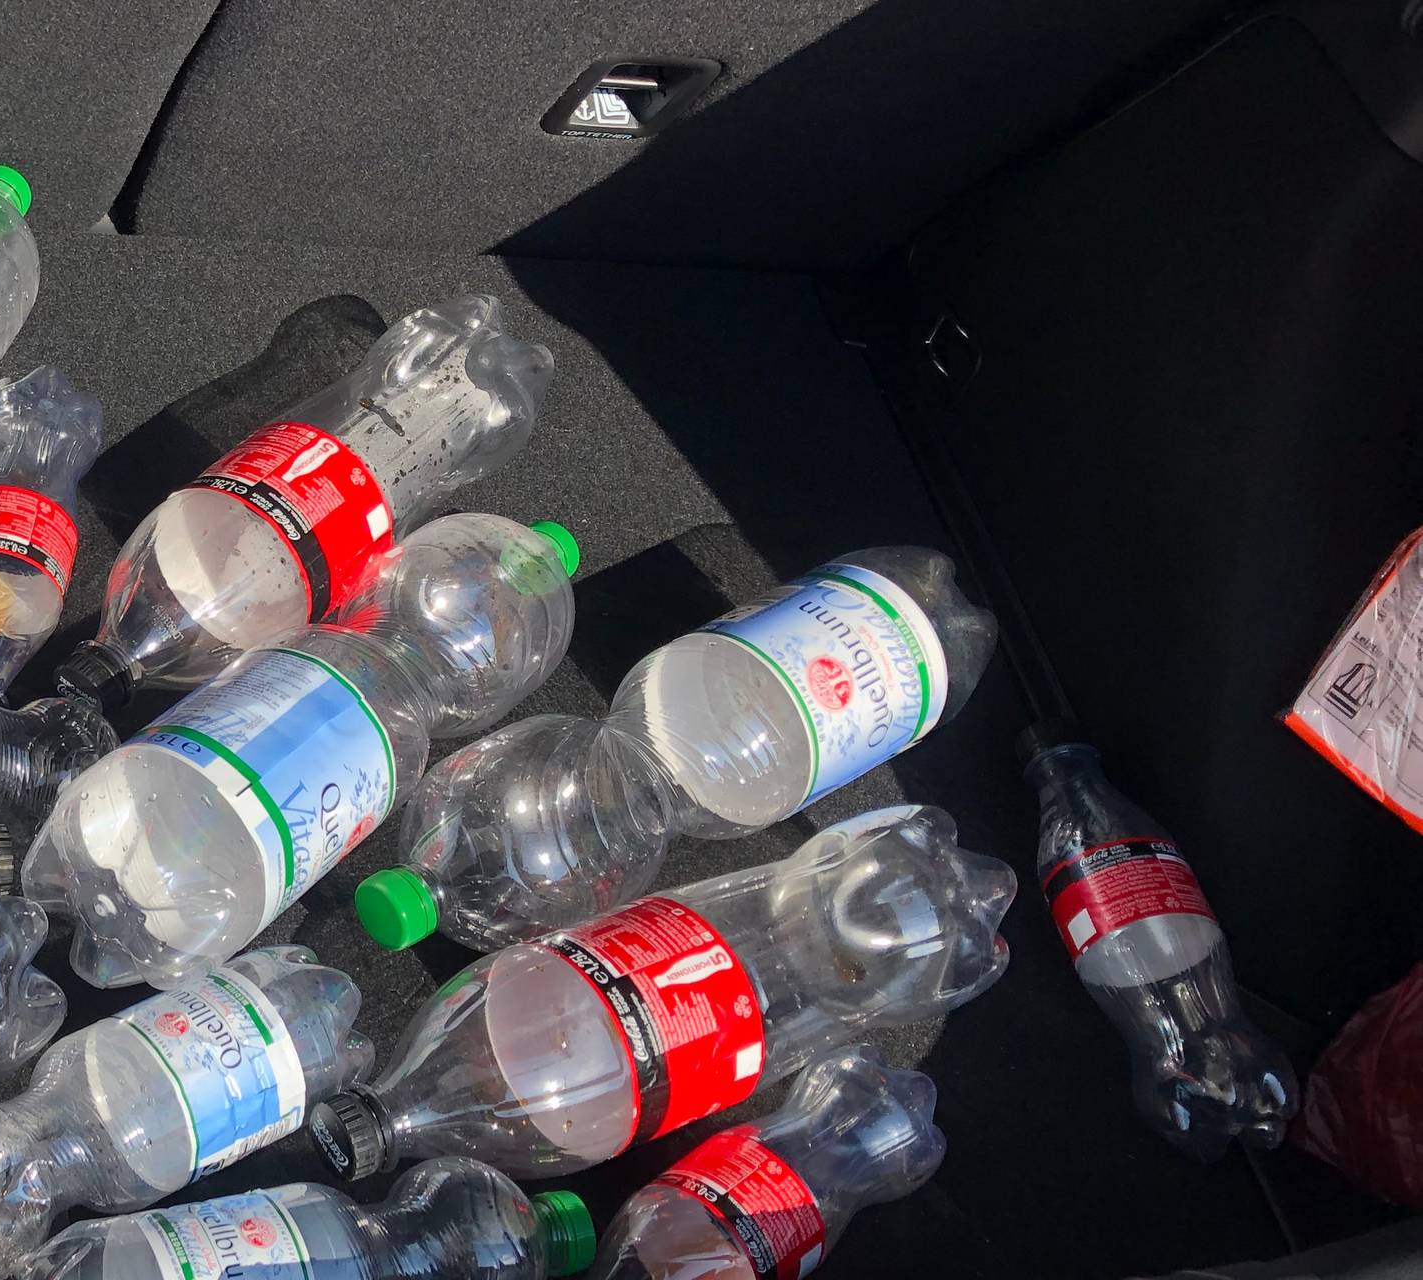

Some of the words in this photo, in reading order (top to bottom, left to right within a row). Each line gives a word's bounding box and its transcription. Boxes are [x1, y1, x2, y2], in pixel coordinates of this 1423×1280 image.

[291, 446, 325, 475] PORTIONEN
[270, 508, 301, 541] Coca-Cola
[799, 600, 894, 748] Quellbrunn
[1079, 850, 1109, 868] Coca-Cola
[666, 958, 712, 982] PORTIONEN
[710, 952, 728, 965] 5
[621, 1015, 649, 1062] Coca-Cola
[735, 1216, 752, 1239] SUGAR
[166, 1229, 189, 1265] MEDIUM
